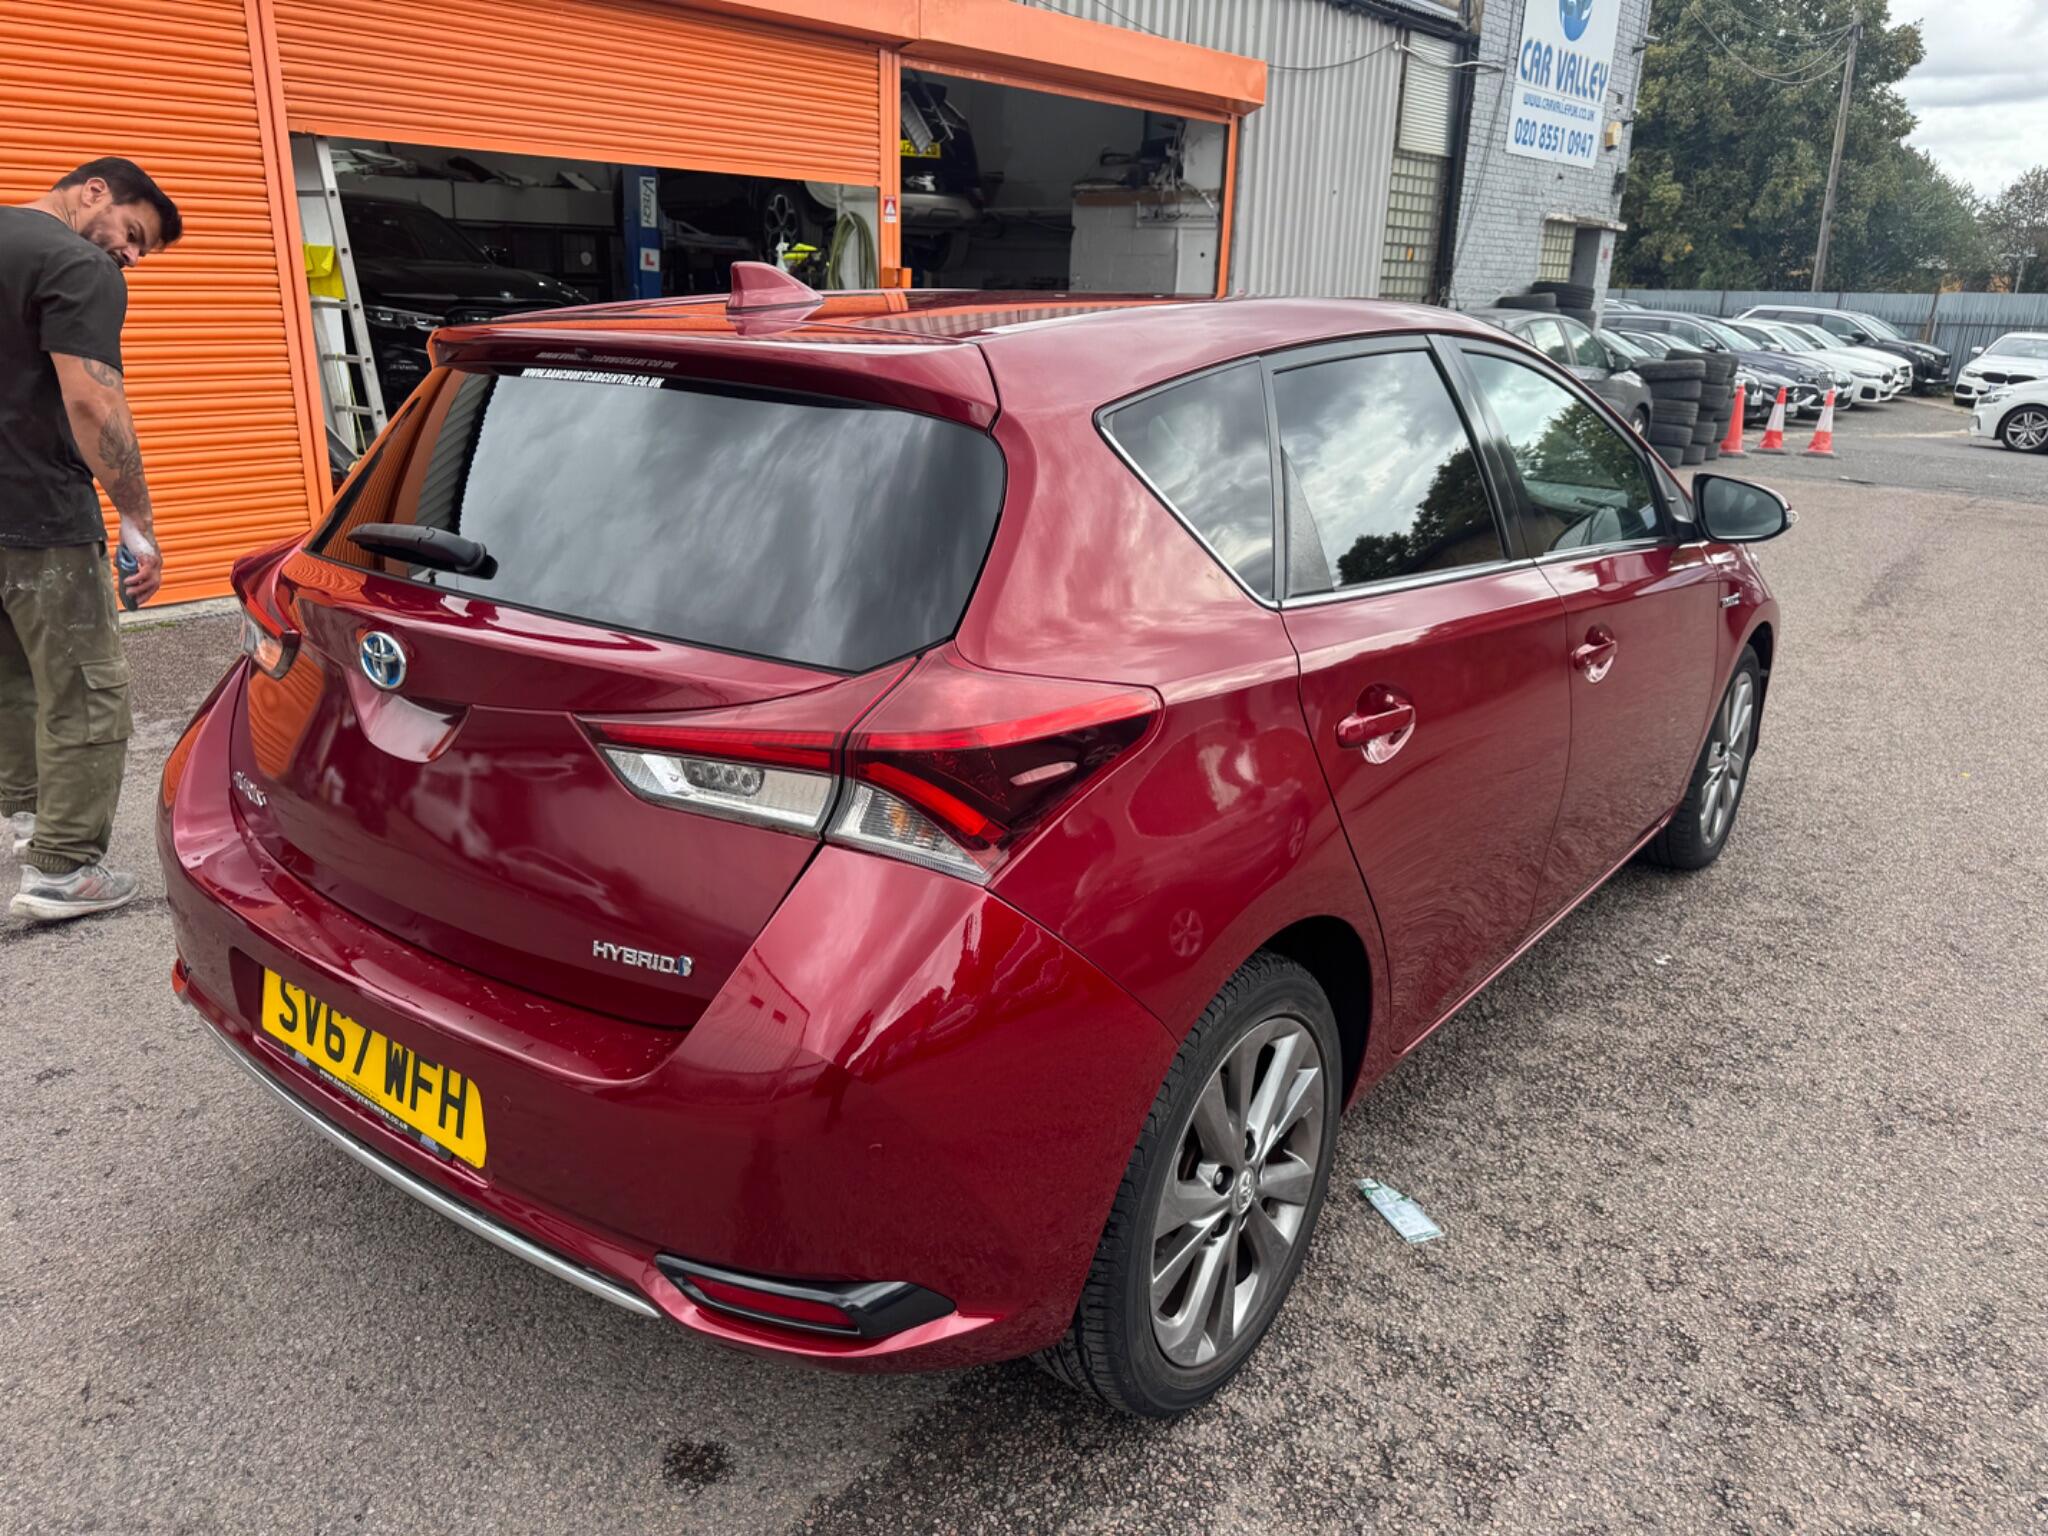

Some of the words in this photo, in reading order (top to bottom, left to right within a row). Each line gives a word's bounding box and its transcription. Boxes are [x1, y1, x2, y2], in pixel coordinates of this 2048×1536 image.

[1520, 40, 1552, 87] CAR
[1556, 49, 1609, 102] VALLEY
[1514, 117, 1537, 147] 020
[1539, 123, 1566, 152] 8551
[1567, 130, 1593, 158] 0947
[593, 940, 675, 974] HYBRID
[279, 976, 372, 1076] SV67
[384, 1038, 469, 1140] WFH
